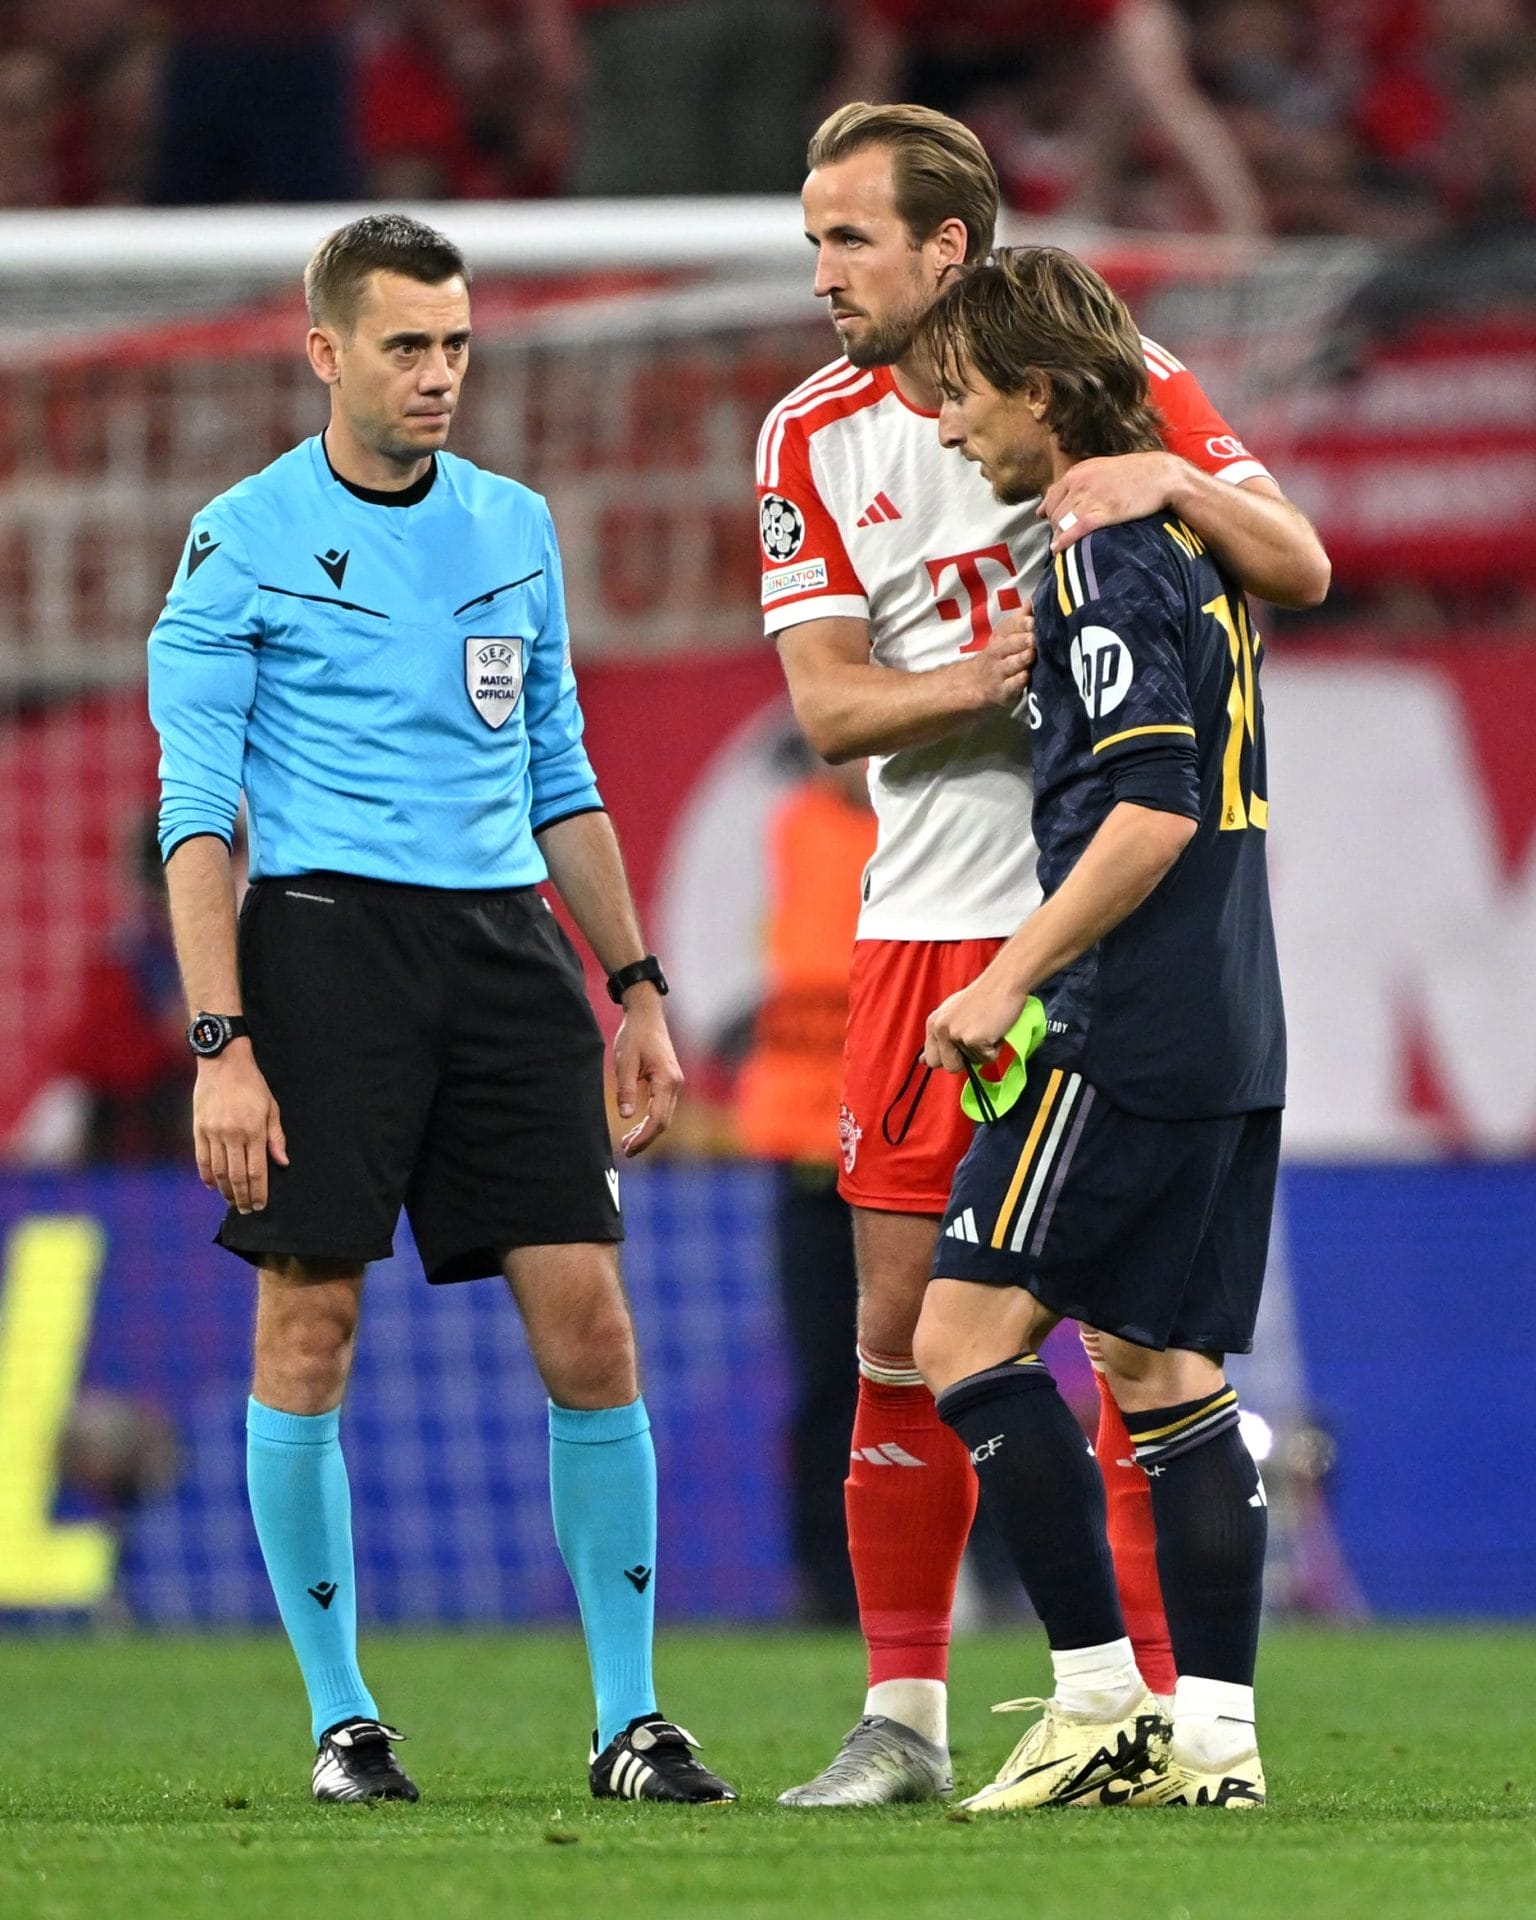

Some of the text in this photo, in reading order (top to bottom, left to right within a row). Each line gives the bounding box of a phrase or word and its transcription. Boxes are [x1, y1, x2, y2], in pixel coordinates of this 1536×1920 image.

[766, 567, 825, 592] UNDATION
[478, 647, 513, 665] UEFA
[479, 675, 513, 686] MATCH
[475, 689, 516, 700] OFFICIAL
[1045, 1019, 1069, 1034] T.RDY
[970, 1433, 1005, 1466] CF
